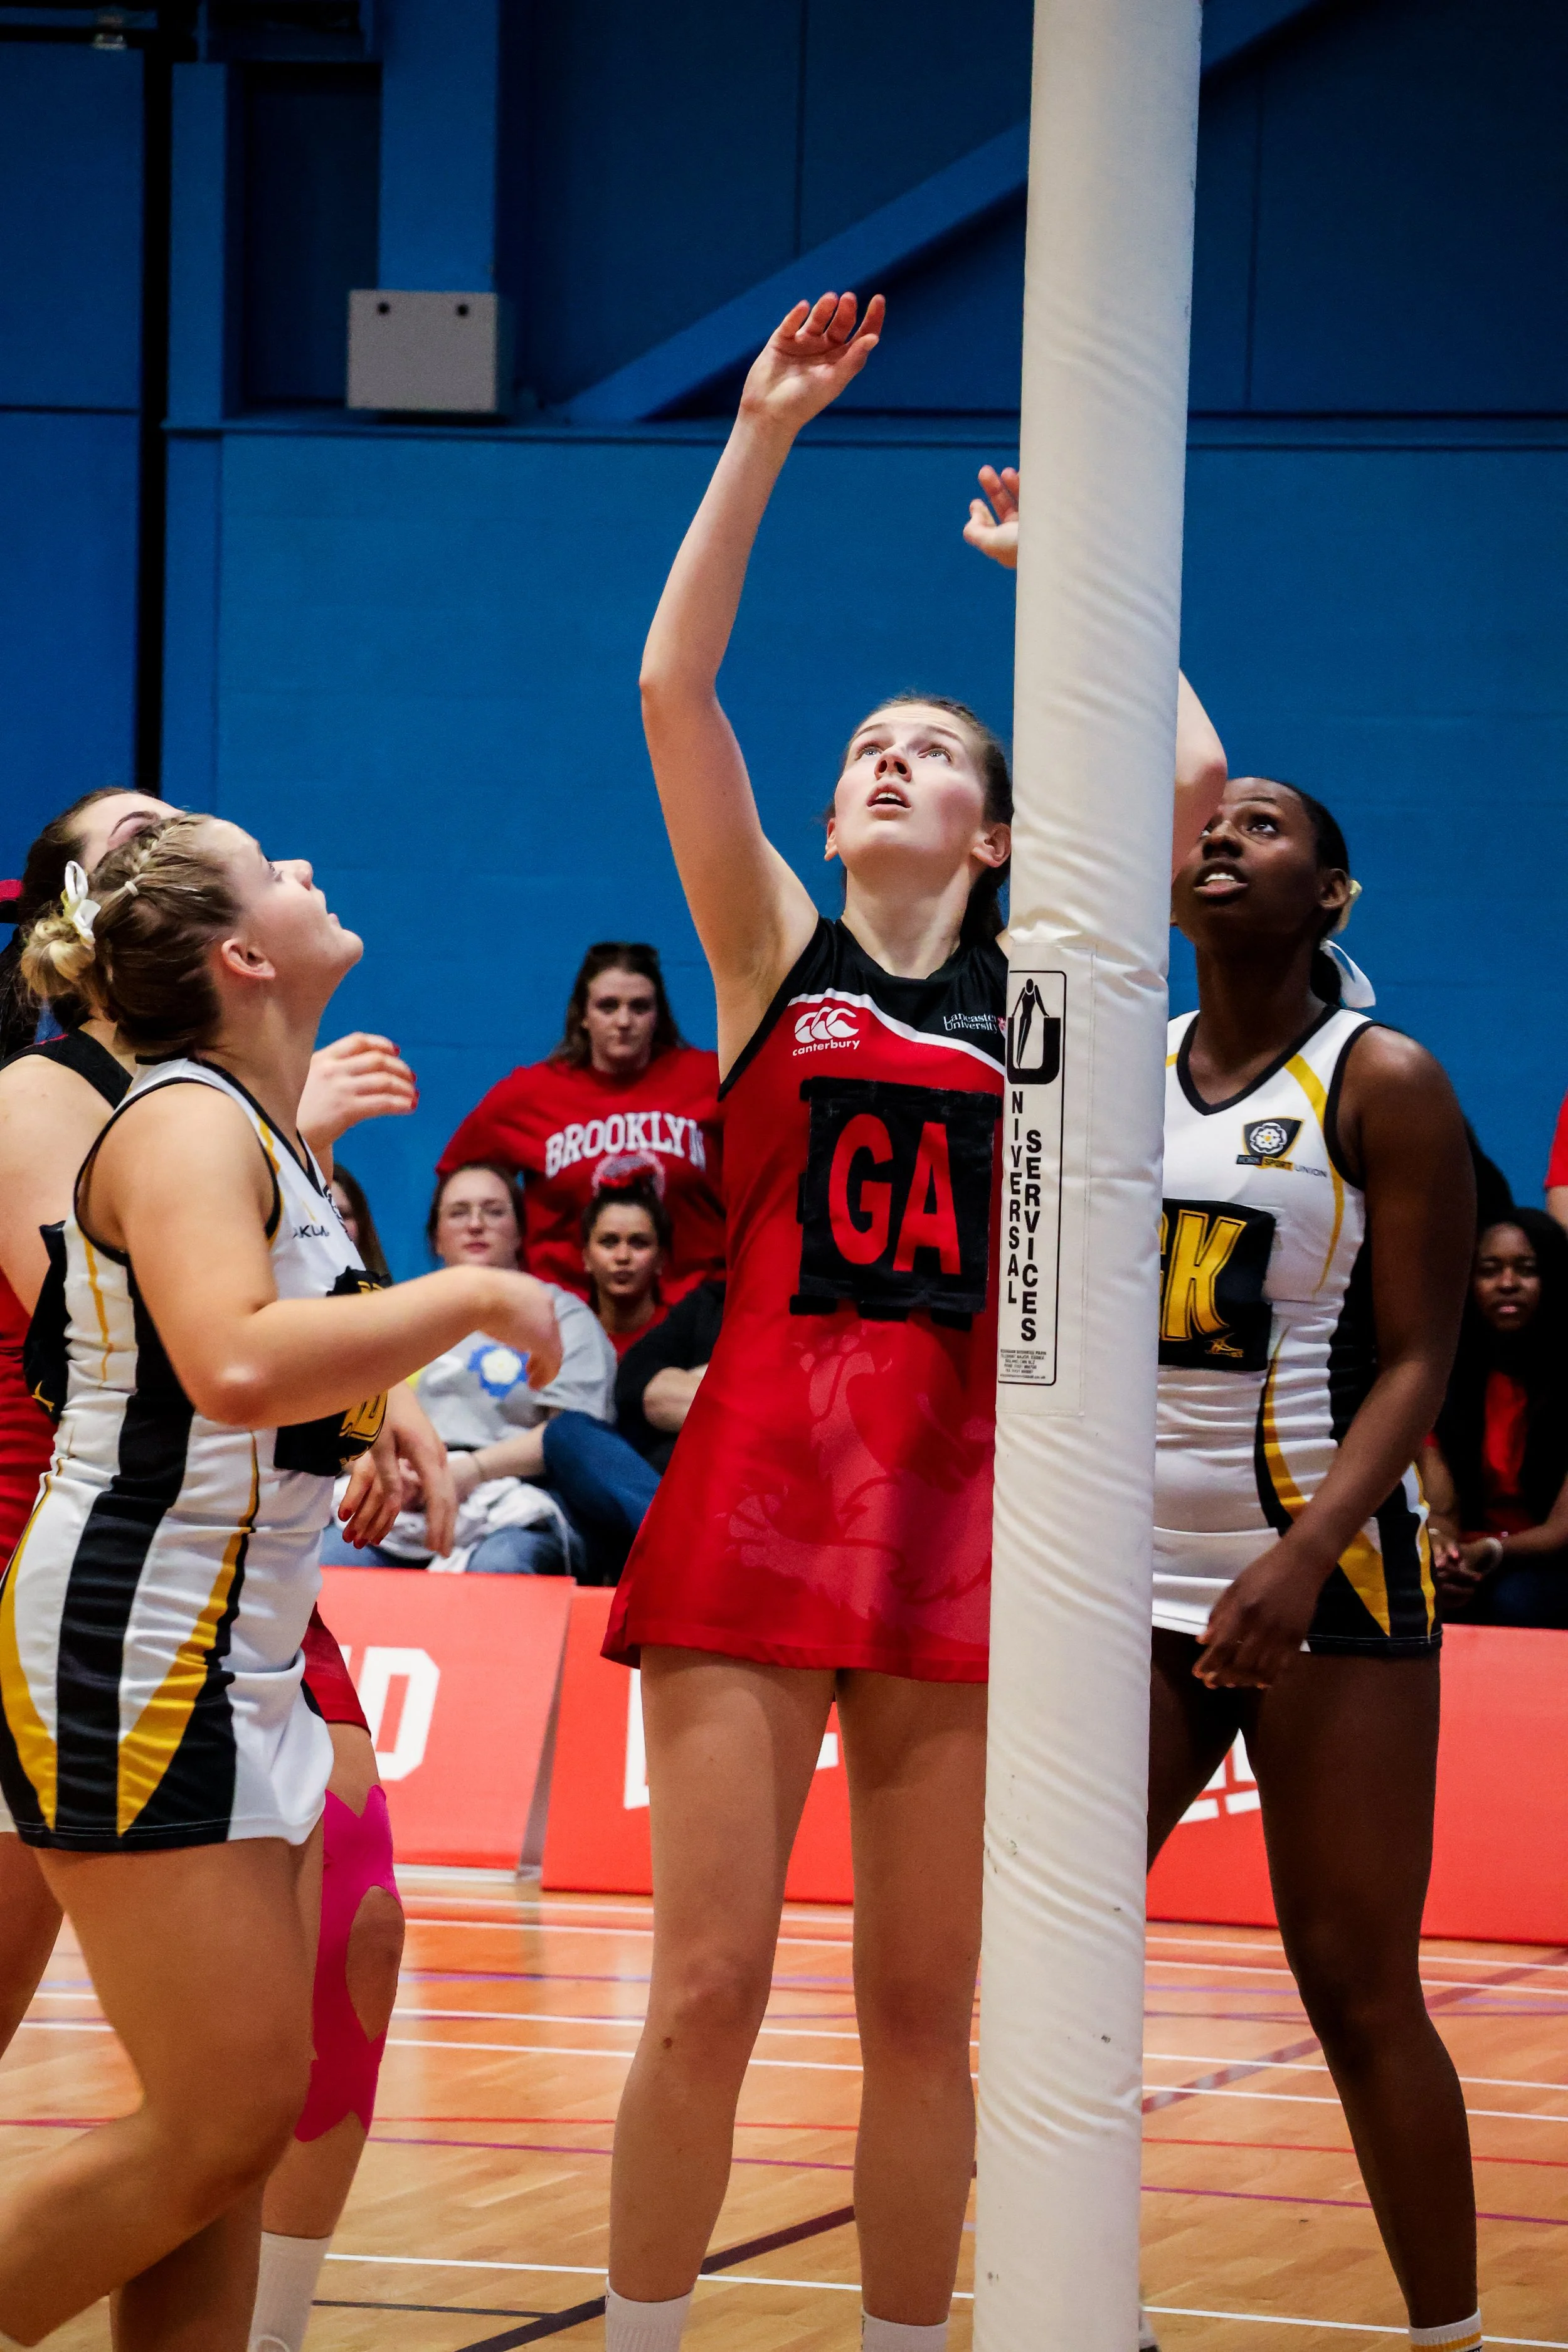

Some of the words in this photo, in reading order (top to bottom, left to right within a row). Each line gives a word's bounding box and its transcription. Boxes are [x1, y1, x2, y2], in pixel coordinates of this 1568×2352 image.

[792, 1039, 860, 1056] canterbury
[545, 1111, 706, 1180] BROOKLYN
[829, 1113, 961, 1274] GA
[1021, 1130, 1042, 1341] SERVICES
[1159, 1209, 1248, 1341] K
